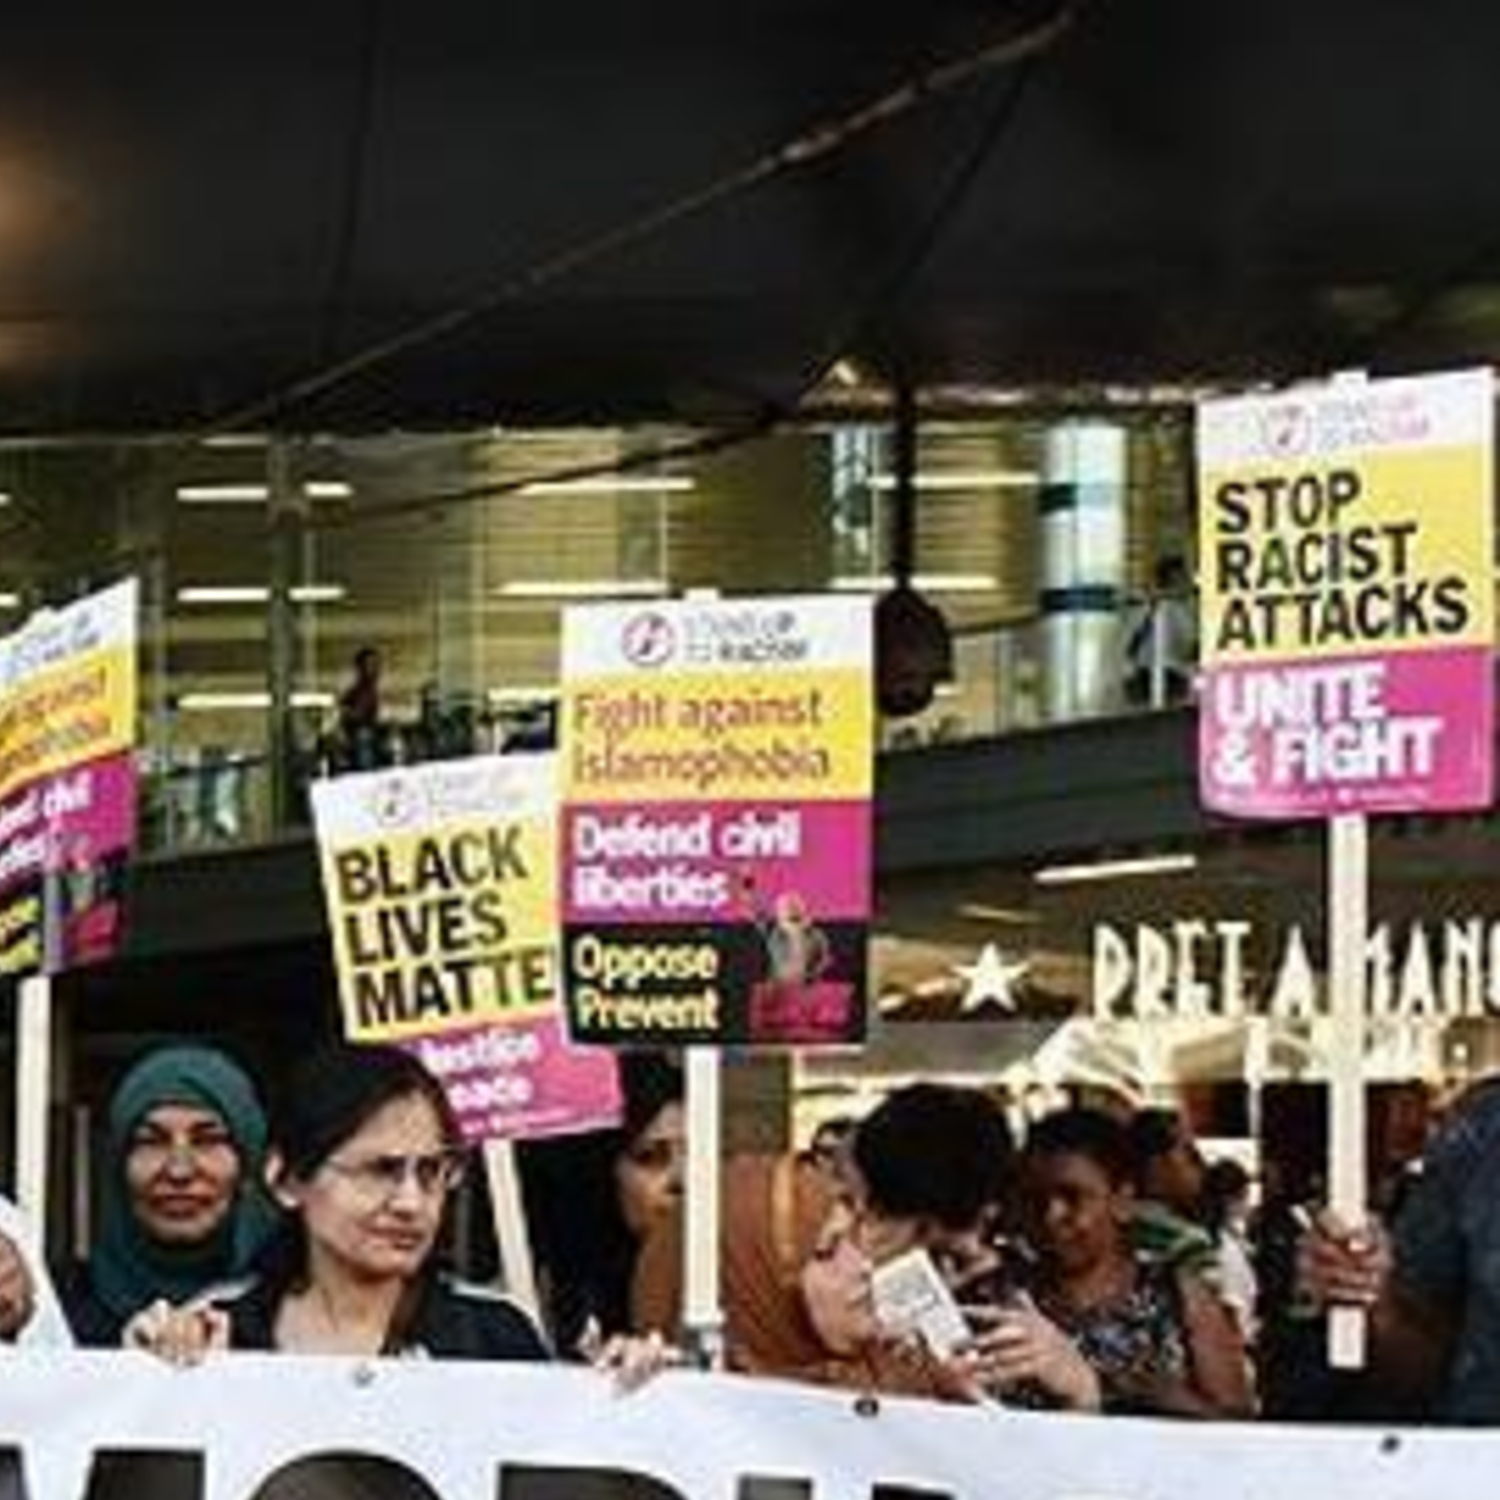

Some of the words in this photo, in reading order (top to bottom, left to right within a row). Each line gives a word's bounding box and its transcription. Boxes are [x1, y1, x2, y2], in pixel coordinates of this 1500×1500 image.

[1215, 471, 1363, 536] STOP
[1216, 524, 1418, 594] RACIST
[1216, 576, 1469, 652] ATTACKS
[575, 690, 666, 742] Fight
[678, 688, 822, 738] against
[1215, 662, 1387, 731] UNITE
[573, 738, 830, 790] Islamophobia
[1210, 729, 1260, 786] &
[1273, 718, 1443, 783] FIGHT
[336, 826, 530, 904] BLACK
[573, 810, 712, 860] Defend
[720, 809, 802, 858] civil
[573, 864, 729, 910] liberties
[344, 892, 509, 966] LIVES
[572, 935, 718, 989] Oppose
[355, 945, 556, 1028] MATTE
[1094, 920, 1252, 1018] PRET
[1271, 924, 1318, 1015] A
[576, 985, 719, 1029] Prevent
